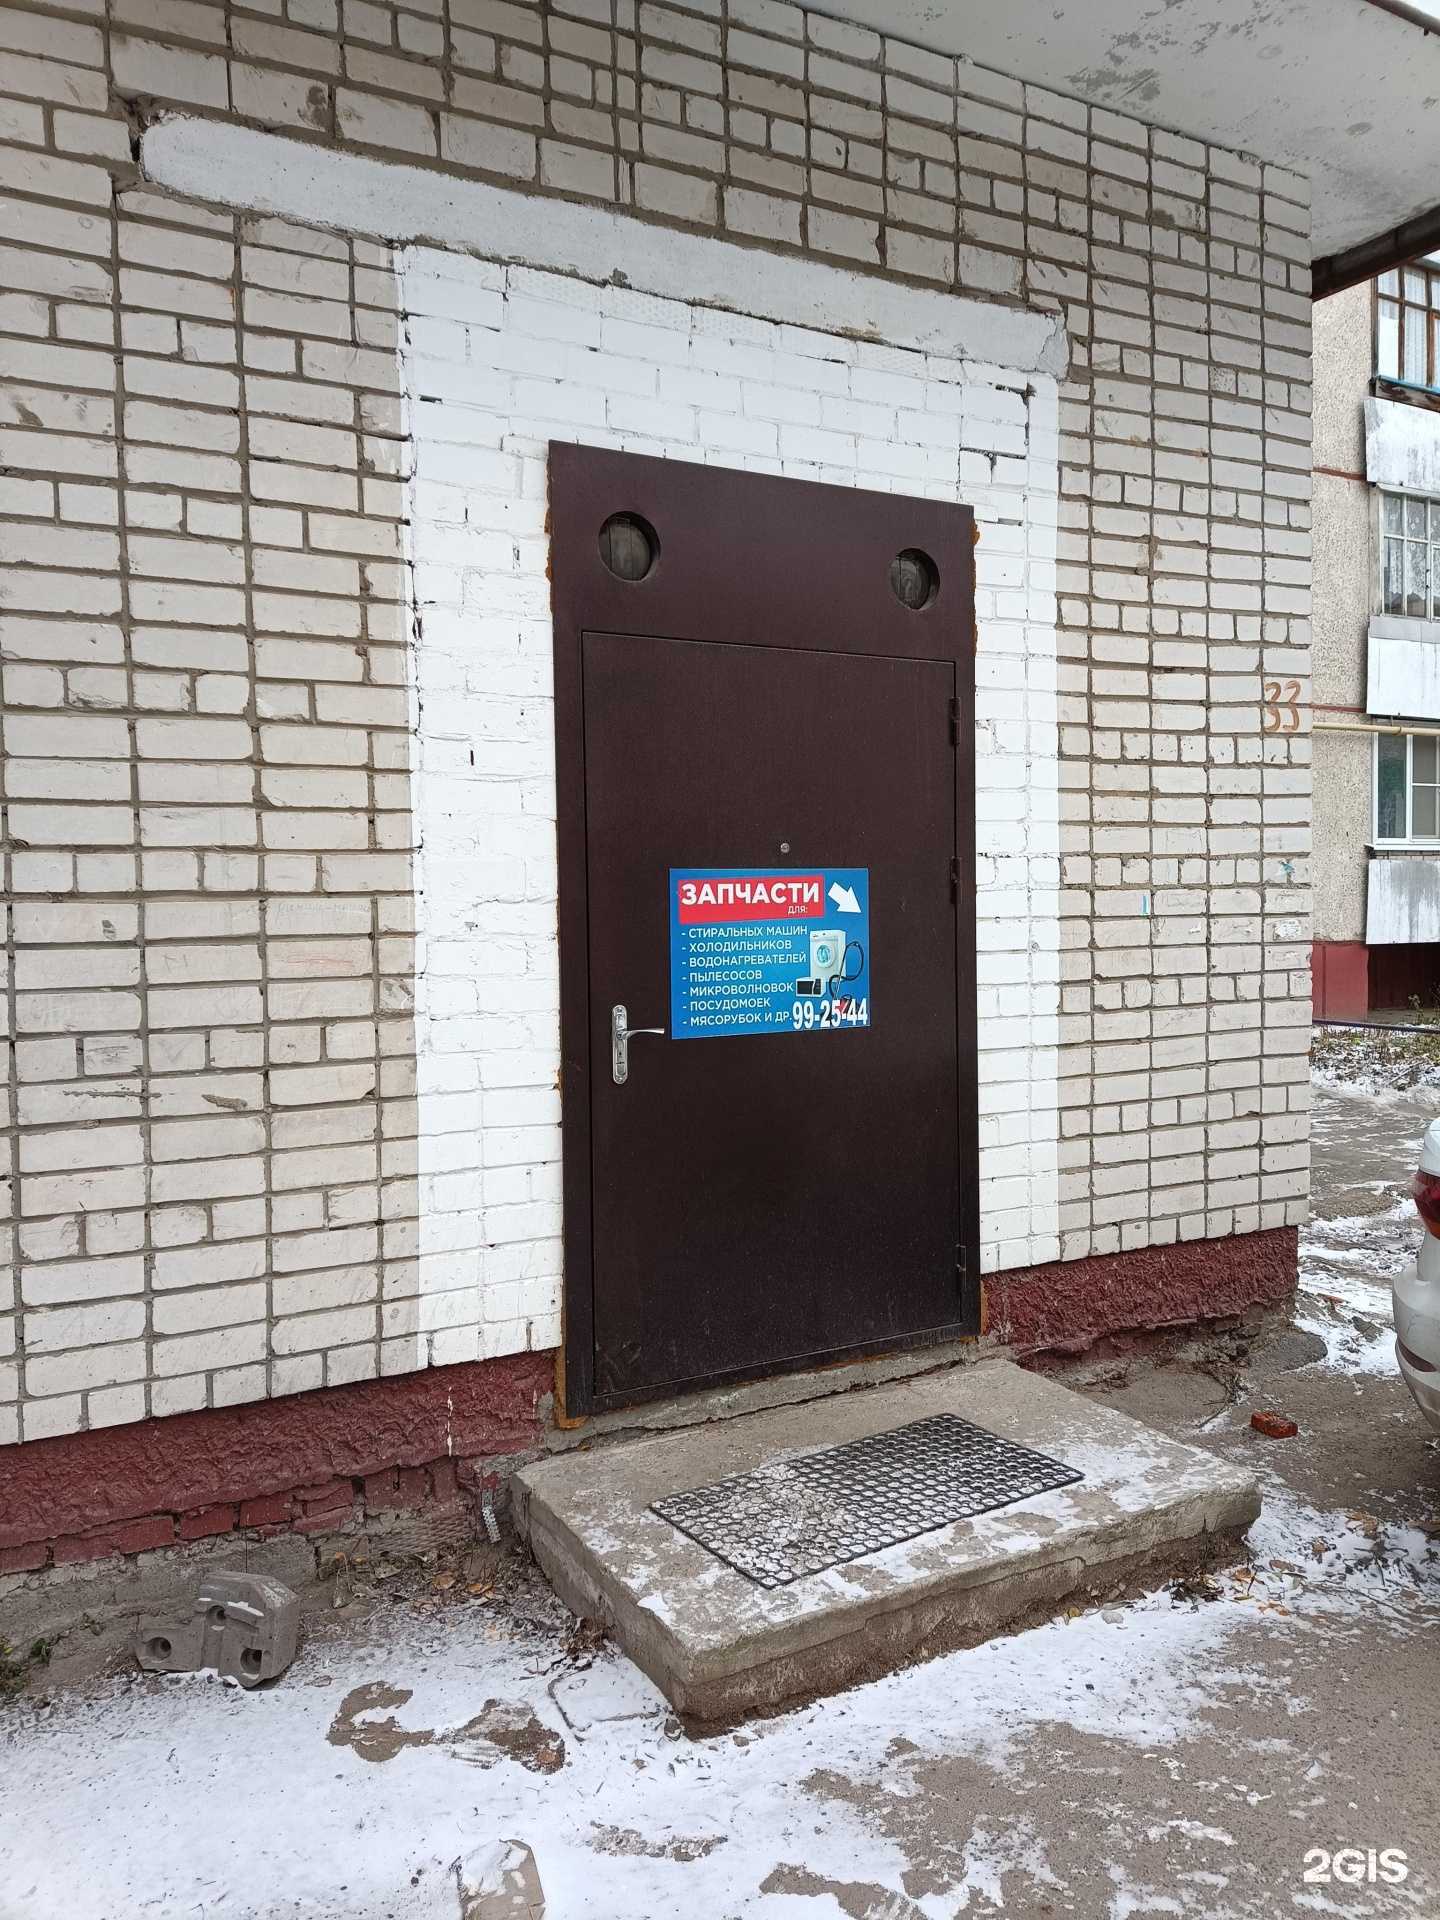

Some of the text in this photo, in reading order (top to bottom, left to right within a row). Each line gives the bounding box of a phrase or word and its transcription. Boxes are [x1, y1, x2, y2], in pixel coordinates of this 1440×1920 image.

[681, 883, 819, 905] ЗАПЧАСТИ
[689, 926, 807, 938] СТИРАЛЬНЫХ МАШИН
[689, 940, 792, 953] ХОЛОДИЛЬНИКОВ
[689, 953, 806, 968] ВОДОНАГРЕВАТЕЛЕЙ
[690, 971, 762, 982] ПЫЛЕСОСОВ
[690, 983, 793, 996] МИКРОВОЛНОВОК
[691, 998, 770, 1011] ПОСУДОМОЕК
[691, 1010, 761, 1026] МЯСОРУБОК
[765, 1012, 772, 1021] И
[793, 998, 867, 1029] 99-25-44
